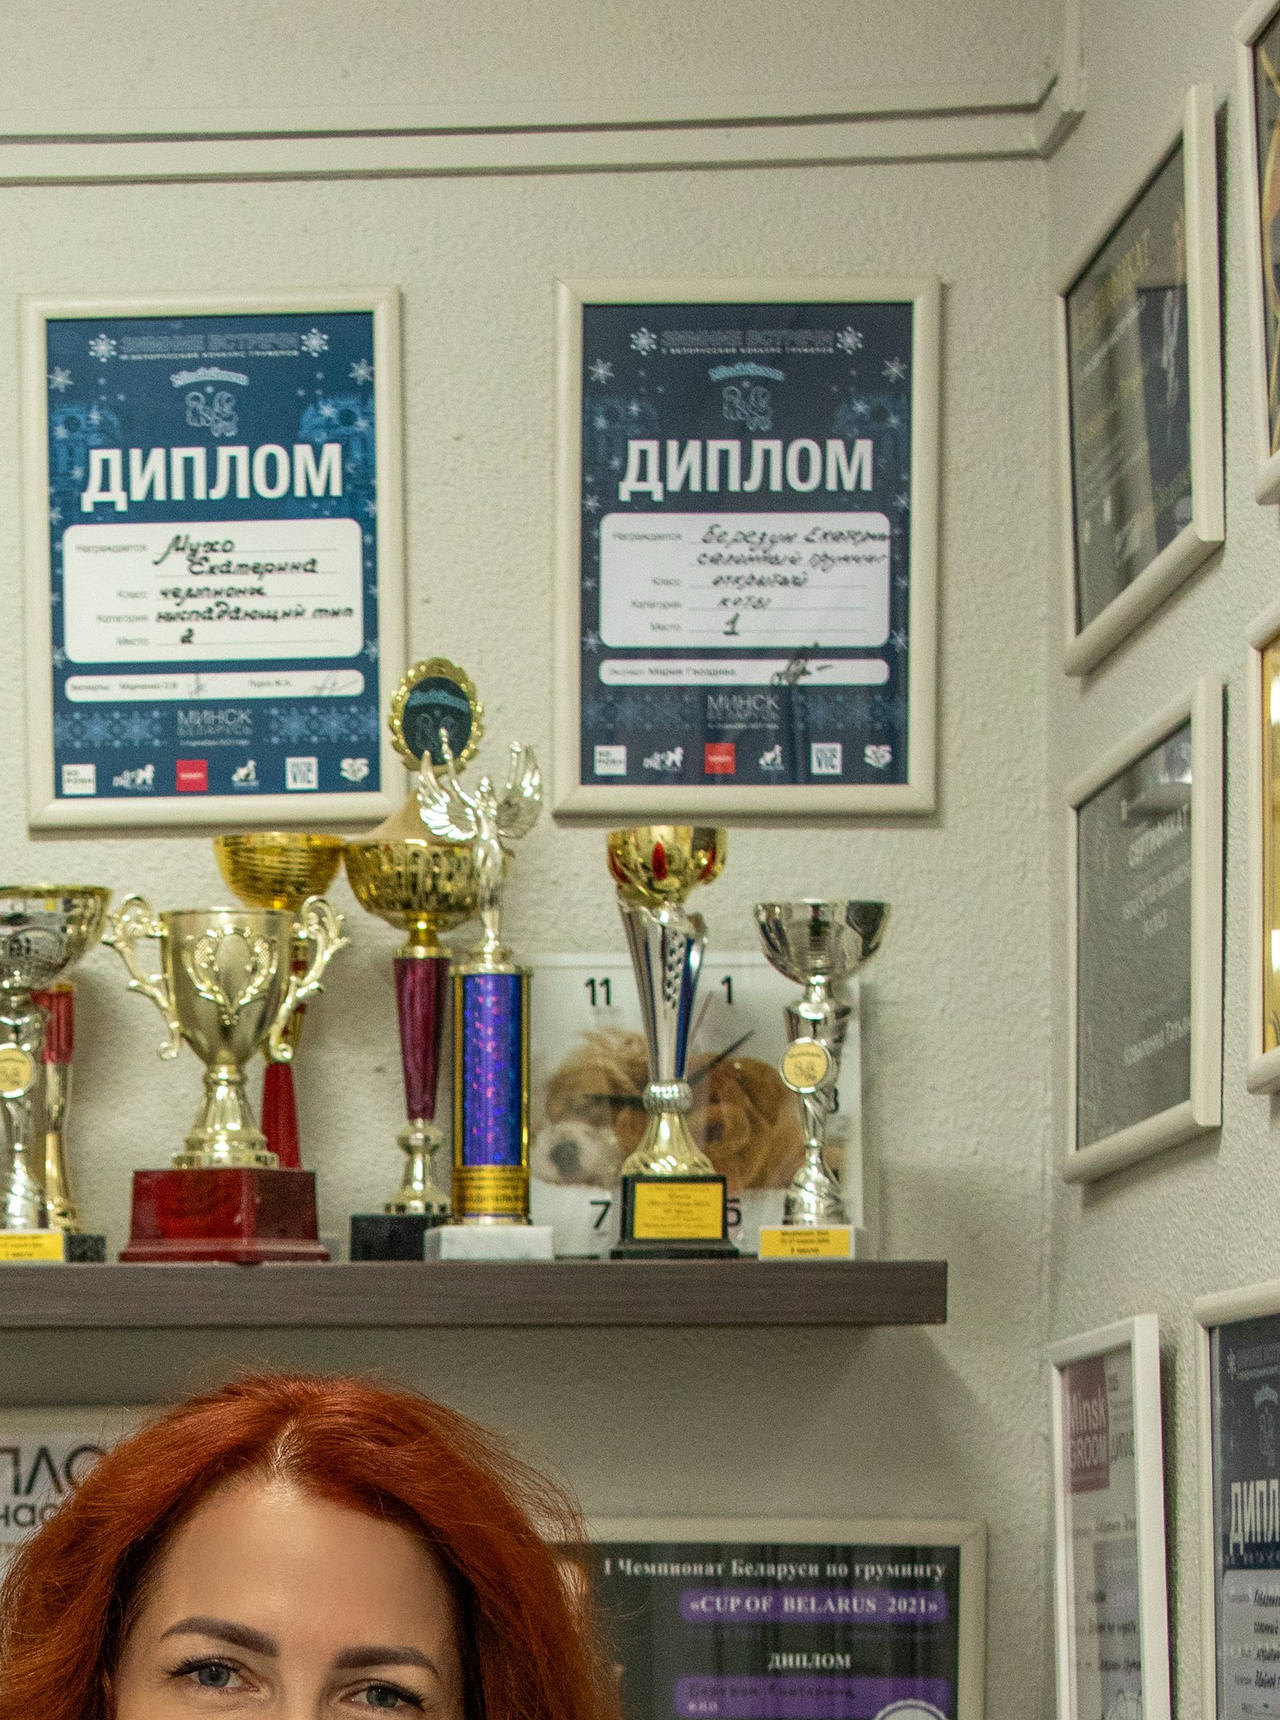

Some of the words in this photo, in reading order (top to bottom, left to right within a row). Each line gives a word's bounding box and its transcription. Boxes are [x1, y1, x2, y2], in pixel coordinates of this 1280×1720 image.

[80, 443, 343, 513] ДИПЛОМ
[618, 438, 873, 502] ДИПЛОМ
[187, 557, 318, 580] Екатерина
[177, 709, 253, 724] МИНСК
[585, 977, 613, 1006] 11
[721, 975, 733, 1004] 1
[589, 1201, 613, 1229] 7
[1229, 1478, 1280, 1555] ДИПЛ
[618, 1559, 723, 1577] Чемпионат
[730, 1559, 820, 1581] Беларуси
[826, 1563, 849, 1577] по
[854, 1563, 946, 1582] грумингу
[744, 1596, 773, 1613] OF
[783, 1596, 877, 1614] BELARUS
[768, 1653, 852, 1671] ДИПЛОМ
